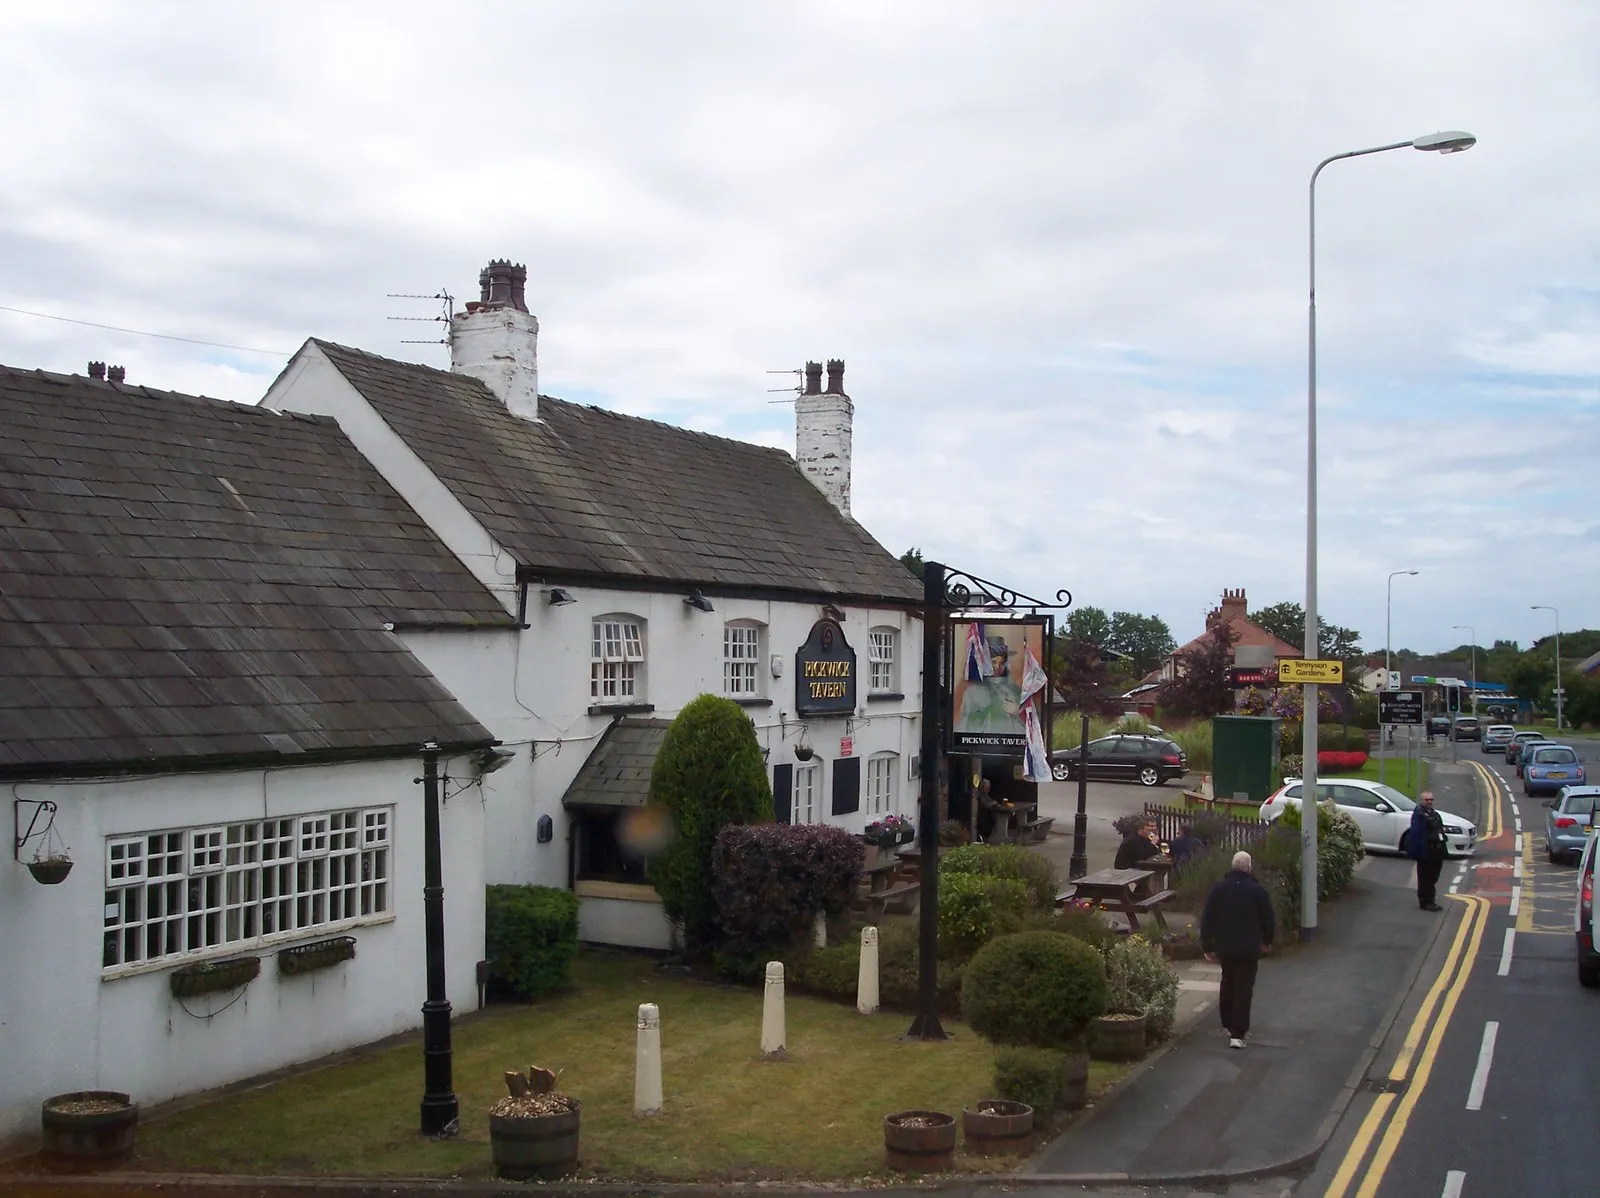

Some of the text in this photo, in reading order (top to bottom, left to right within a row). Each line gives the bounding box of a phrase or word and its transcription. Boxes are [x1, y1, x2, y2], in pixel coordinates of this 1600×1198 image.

[804, 661, 850, 677] PICKWICK
[1295, 661, 1328, 669] Tennyson
[809, 681, 846, 698] TAVERN
[961, 736, 1026, 746] PICKWICK TAVER
